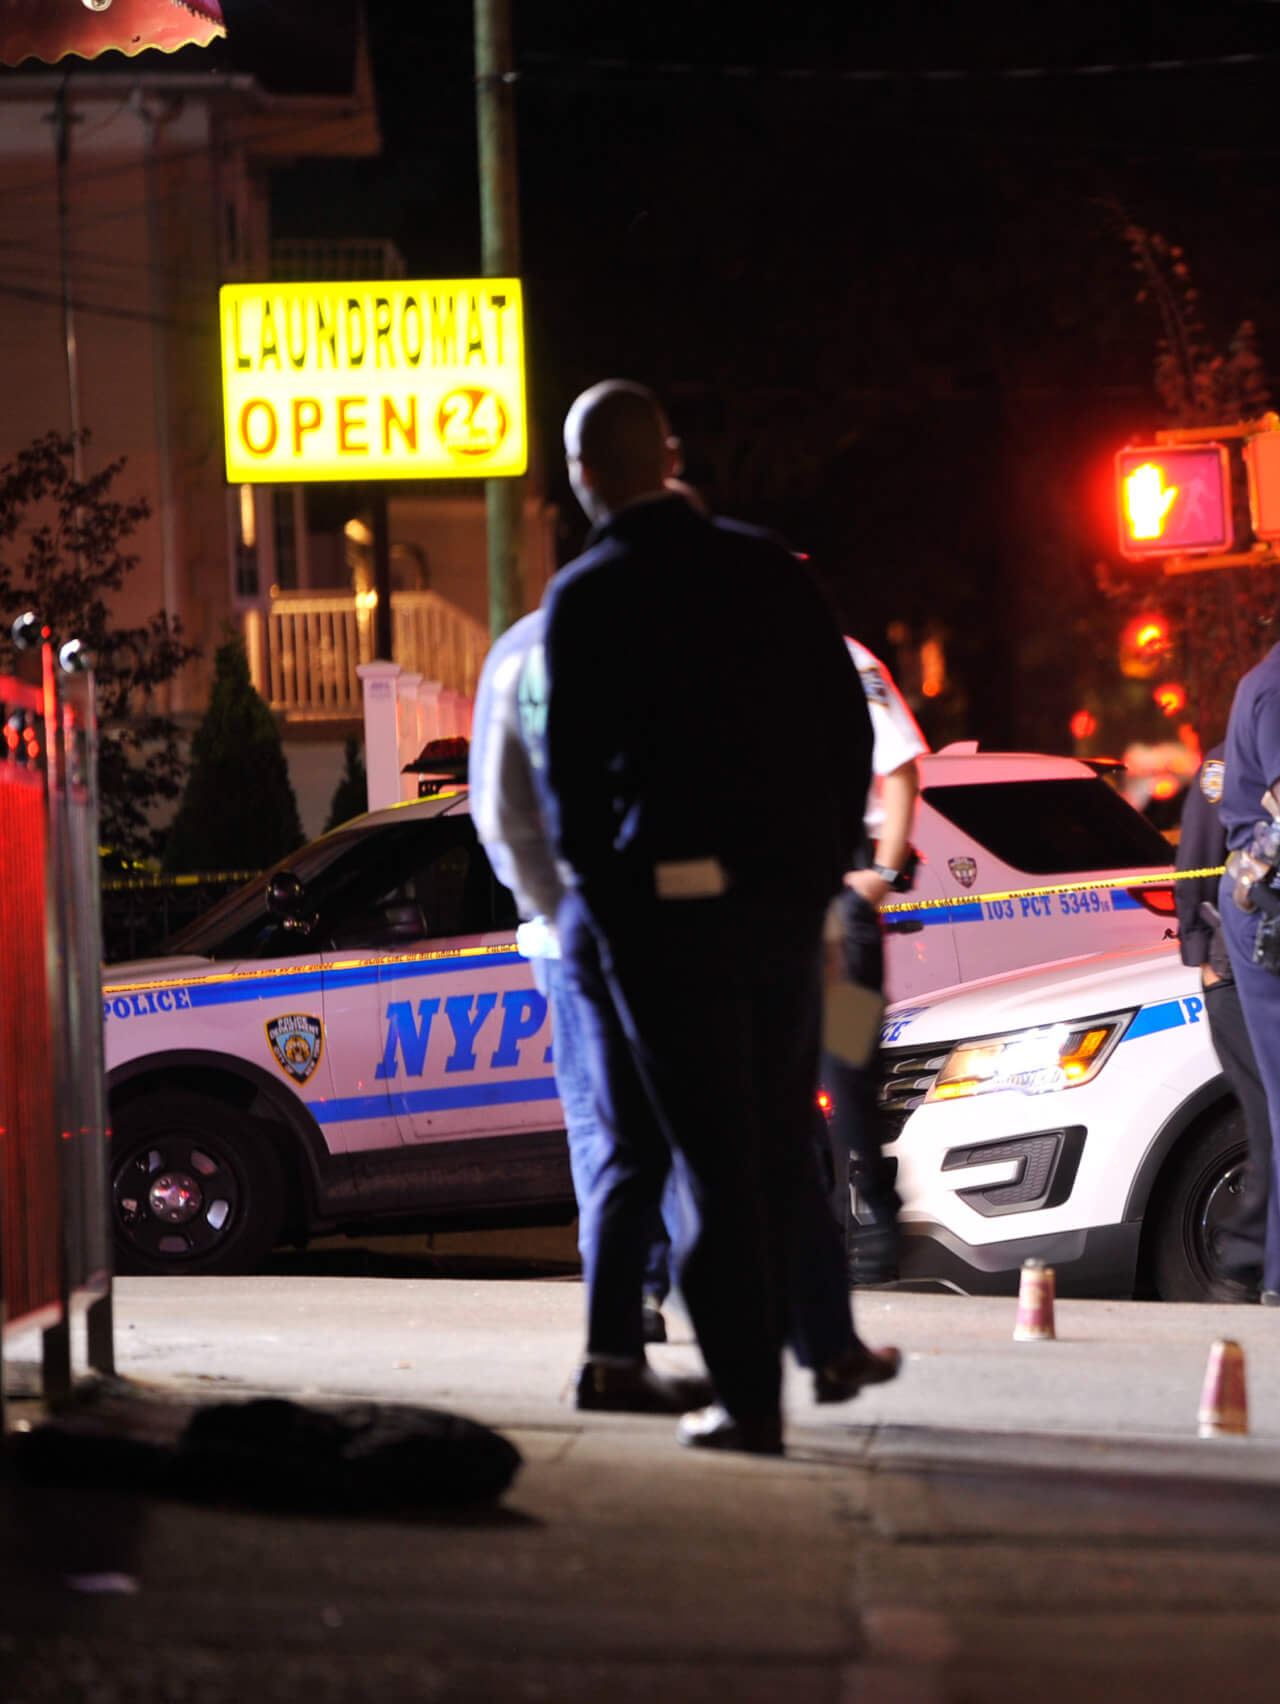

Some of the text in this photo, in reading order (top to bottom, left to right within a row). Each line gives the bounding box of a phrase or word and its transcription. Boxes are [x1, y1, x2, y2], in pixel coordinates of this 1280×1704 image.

[233, 294, 507, 370] LAUNDROMAT
[239, 391, 502, 457] OPEN 24
[985, 899, 1015, 920] 103
[1019, 895, 1052, 917] PCT
[1058, 891, 1101, 915] 5349
[375, 988, 554, 1080] NYP
